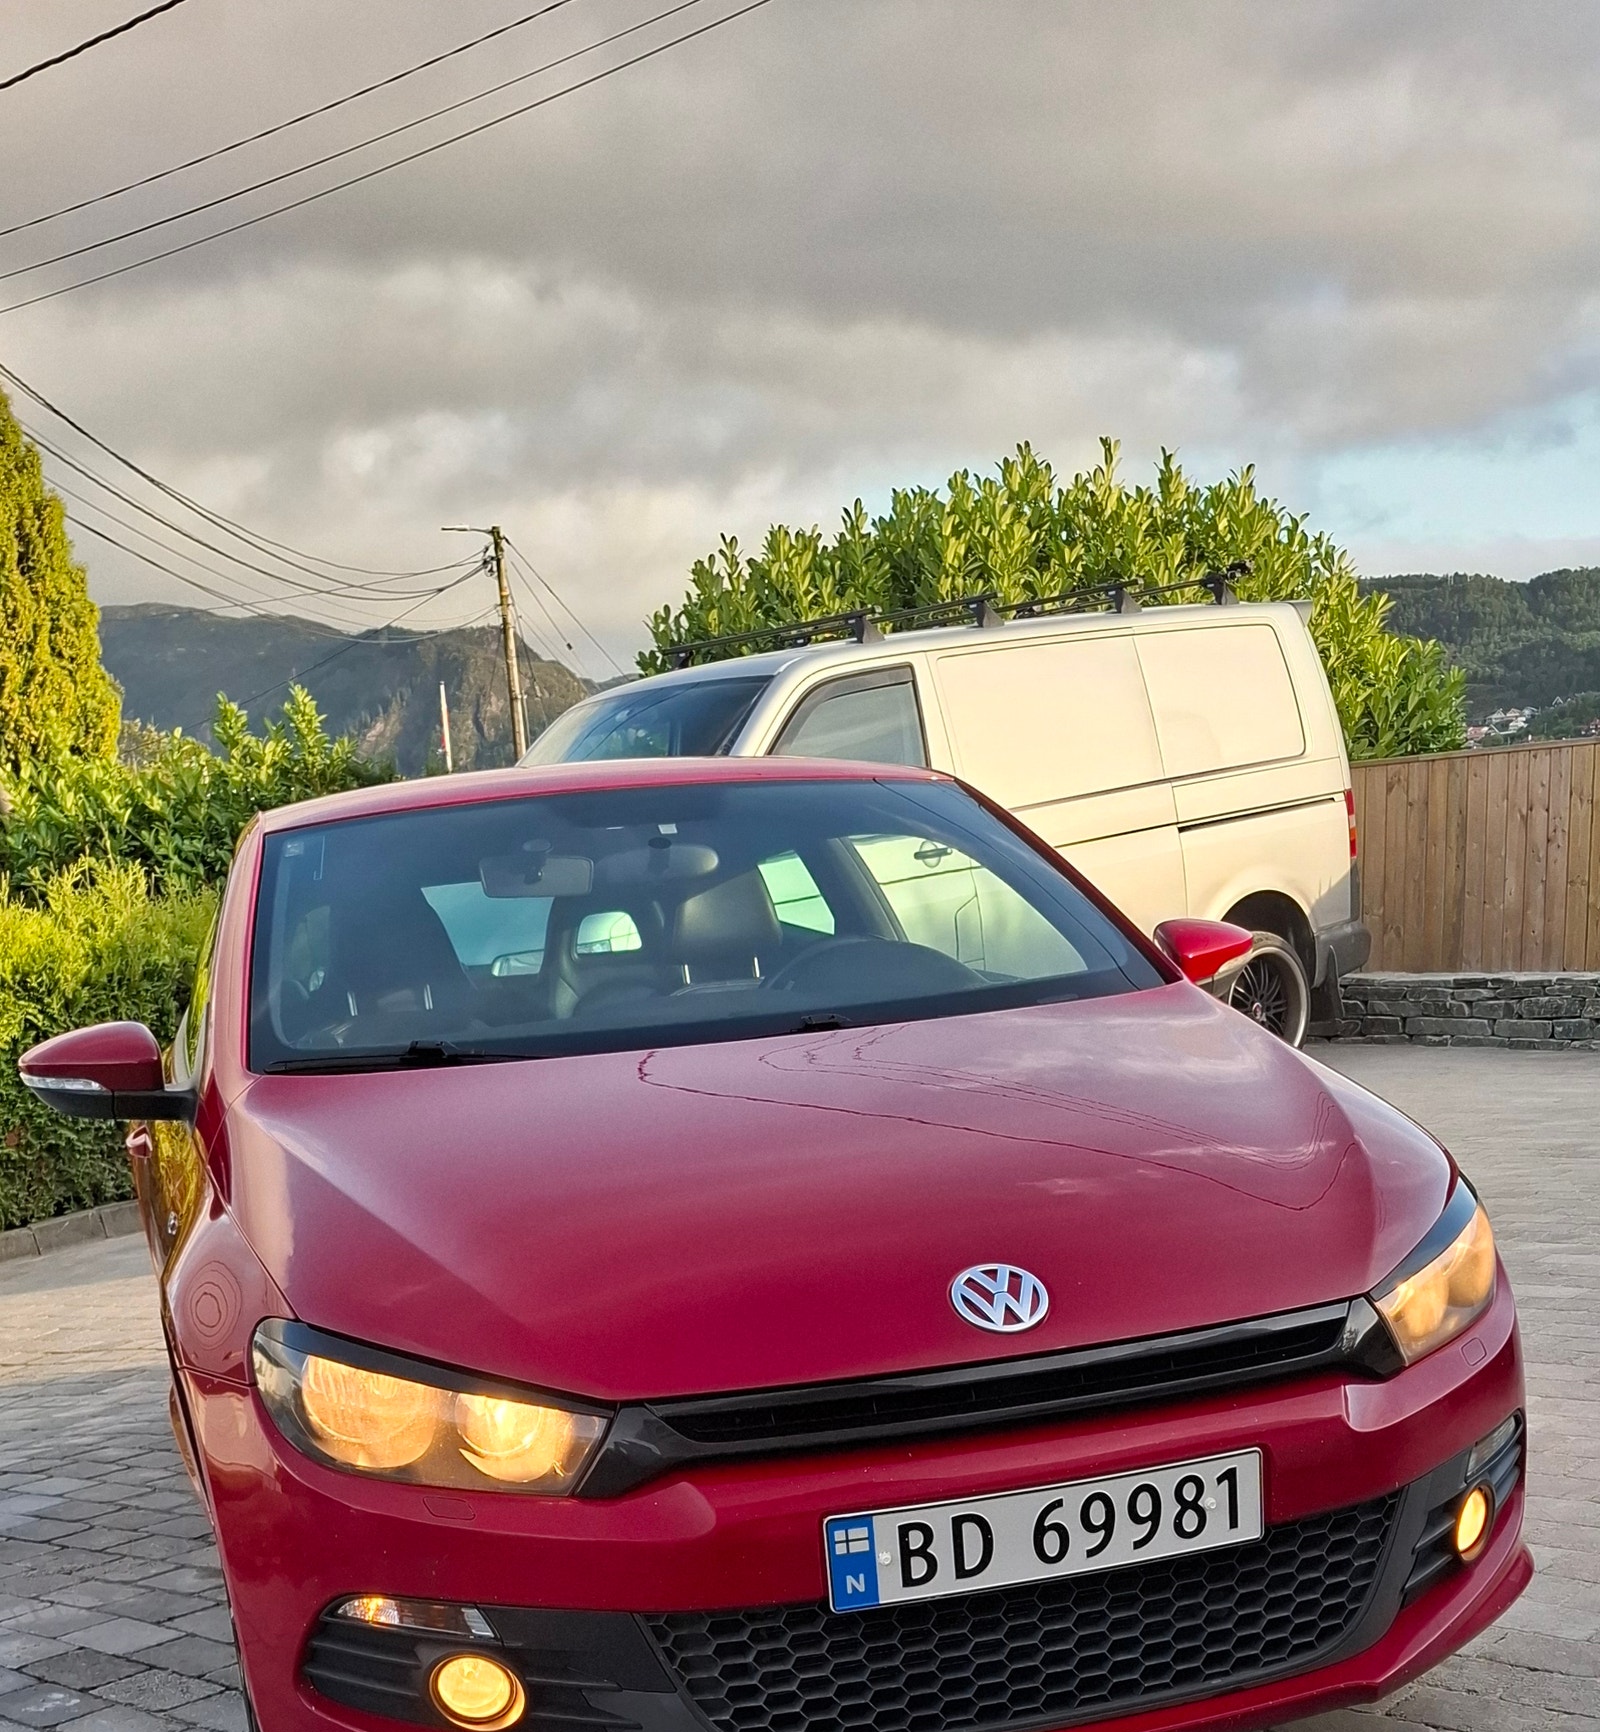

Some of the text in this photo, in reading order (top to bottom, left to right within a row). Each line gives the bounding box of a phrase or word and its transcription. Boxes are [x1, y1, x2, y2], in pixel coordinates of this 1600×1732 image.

[897, 1466, 1239, 1588] BD 69981
[845, 1572, 866, 1595] N
